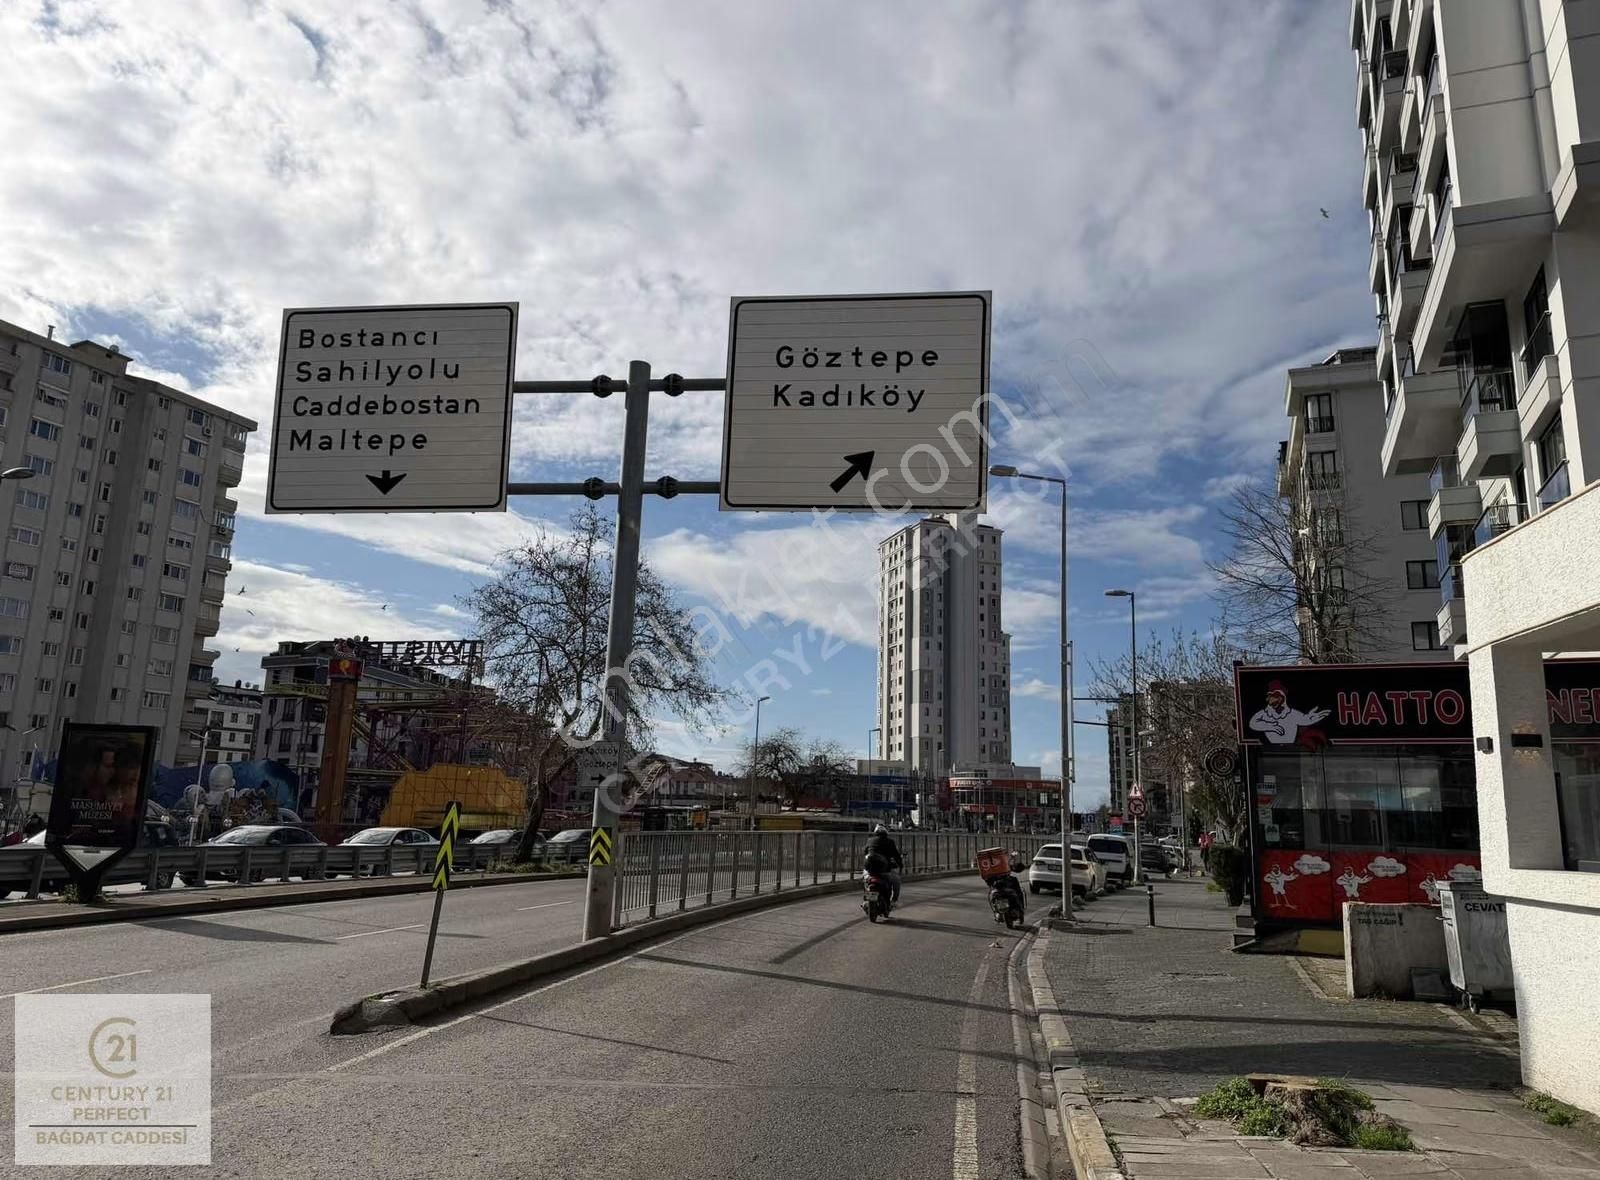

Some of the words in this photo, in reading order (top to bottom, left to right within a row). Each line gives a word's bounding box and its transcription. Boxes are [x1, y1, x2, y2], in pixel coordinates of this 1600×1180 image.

[299, 329, 439, 349] Bostancı
[296, 358, 461, 387] Sahilyolu
[776, 345, 941, 375] Göztepe
[293, 394, 481, 417] Caddebostan
[773, 383, 927, 413] Kadıköy
[289, 428, 429, 457] Maltepe
[1337, 689, 1465, 726] HATTO
